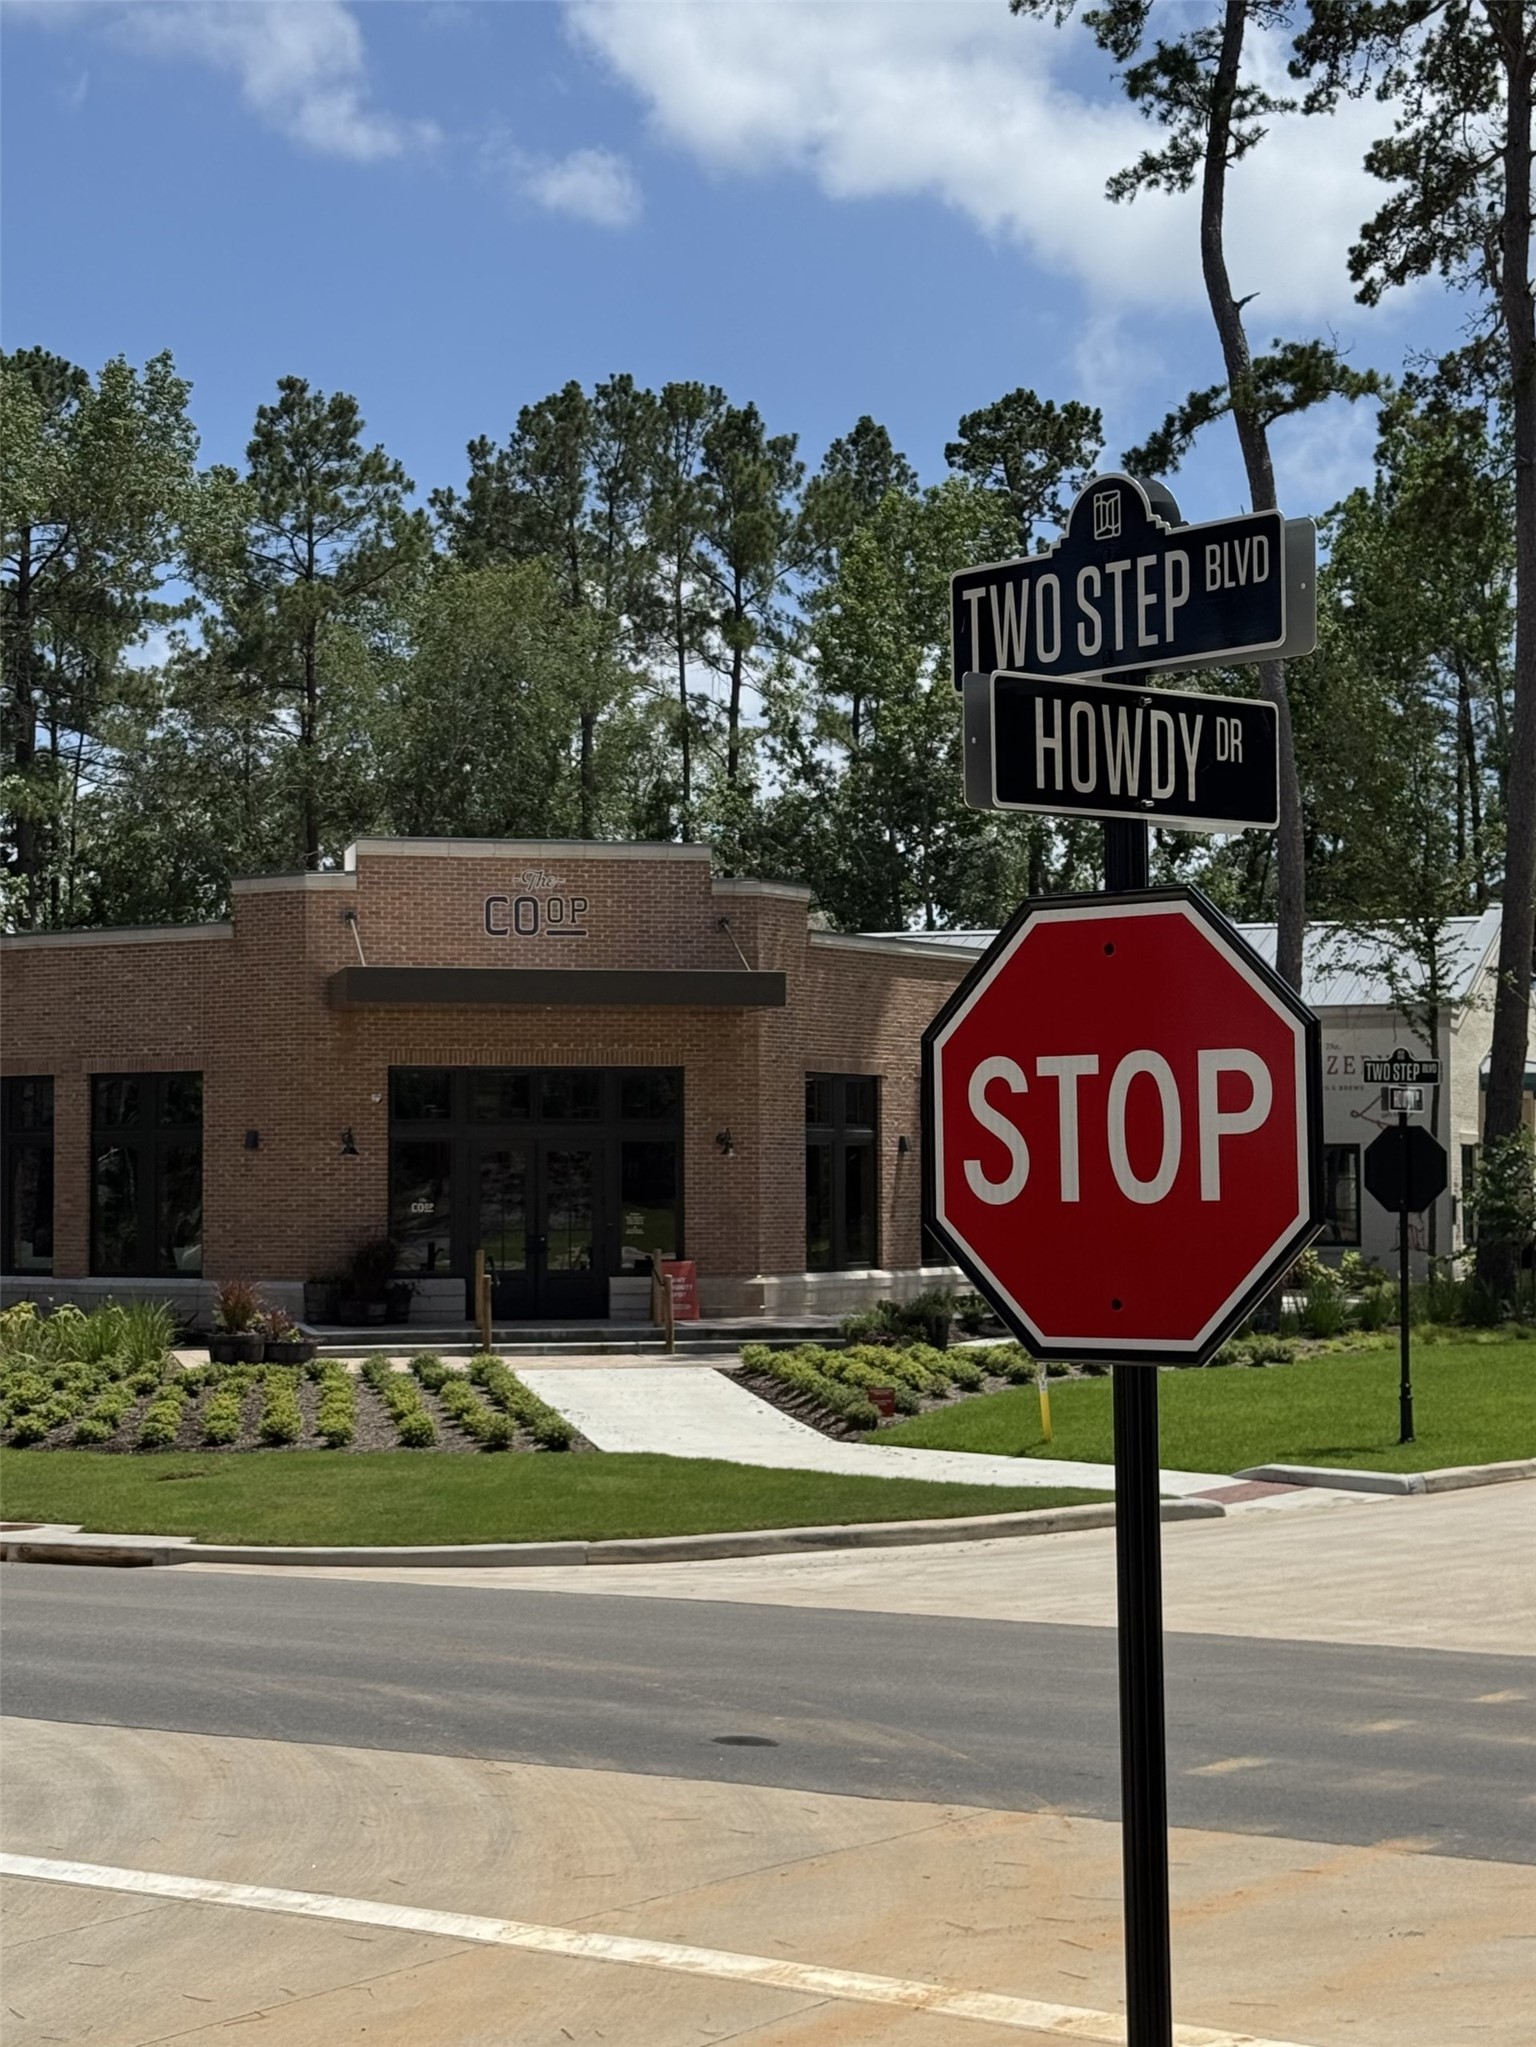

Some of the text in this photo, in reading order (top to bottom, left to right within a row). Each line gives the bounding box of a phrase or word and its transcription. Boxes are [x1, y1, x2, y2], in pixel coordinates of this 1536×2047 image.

[962, 534, 1270, 673] TWO STEP BLVD
[1035, 696, 1243, 802] HOWDY DR
[520, 869, 558, 892] The
[1365, 1063, 1391, 1082] TWO
[1392, 1063, 1421, 1082] STEP
[963, 1047, 1273, 1206] STOP
